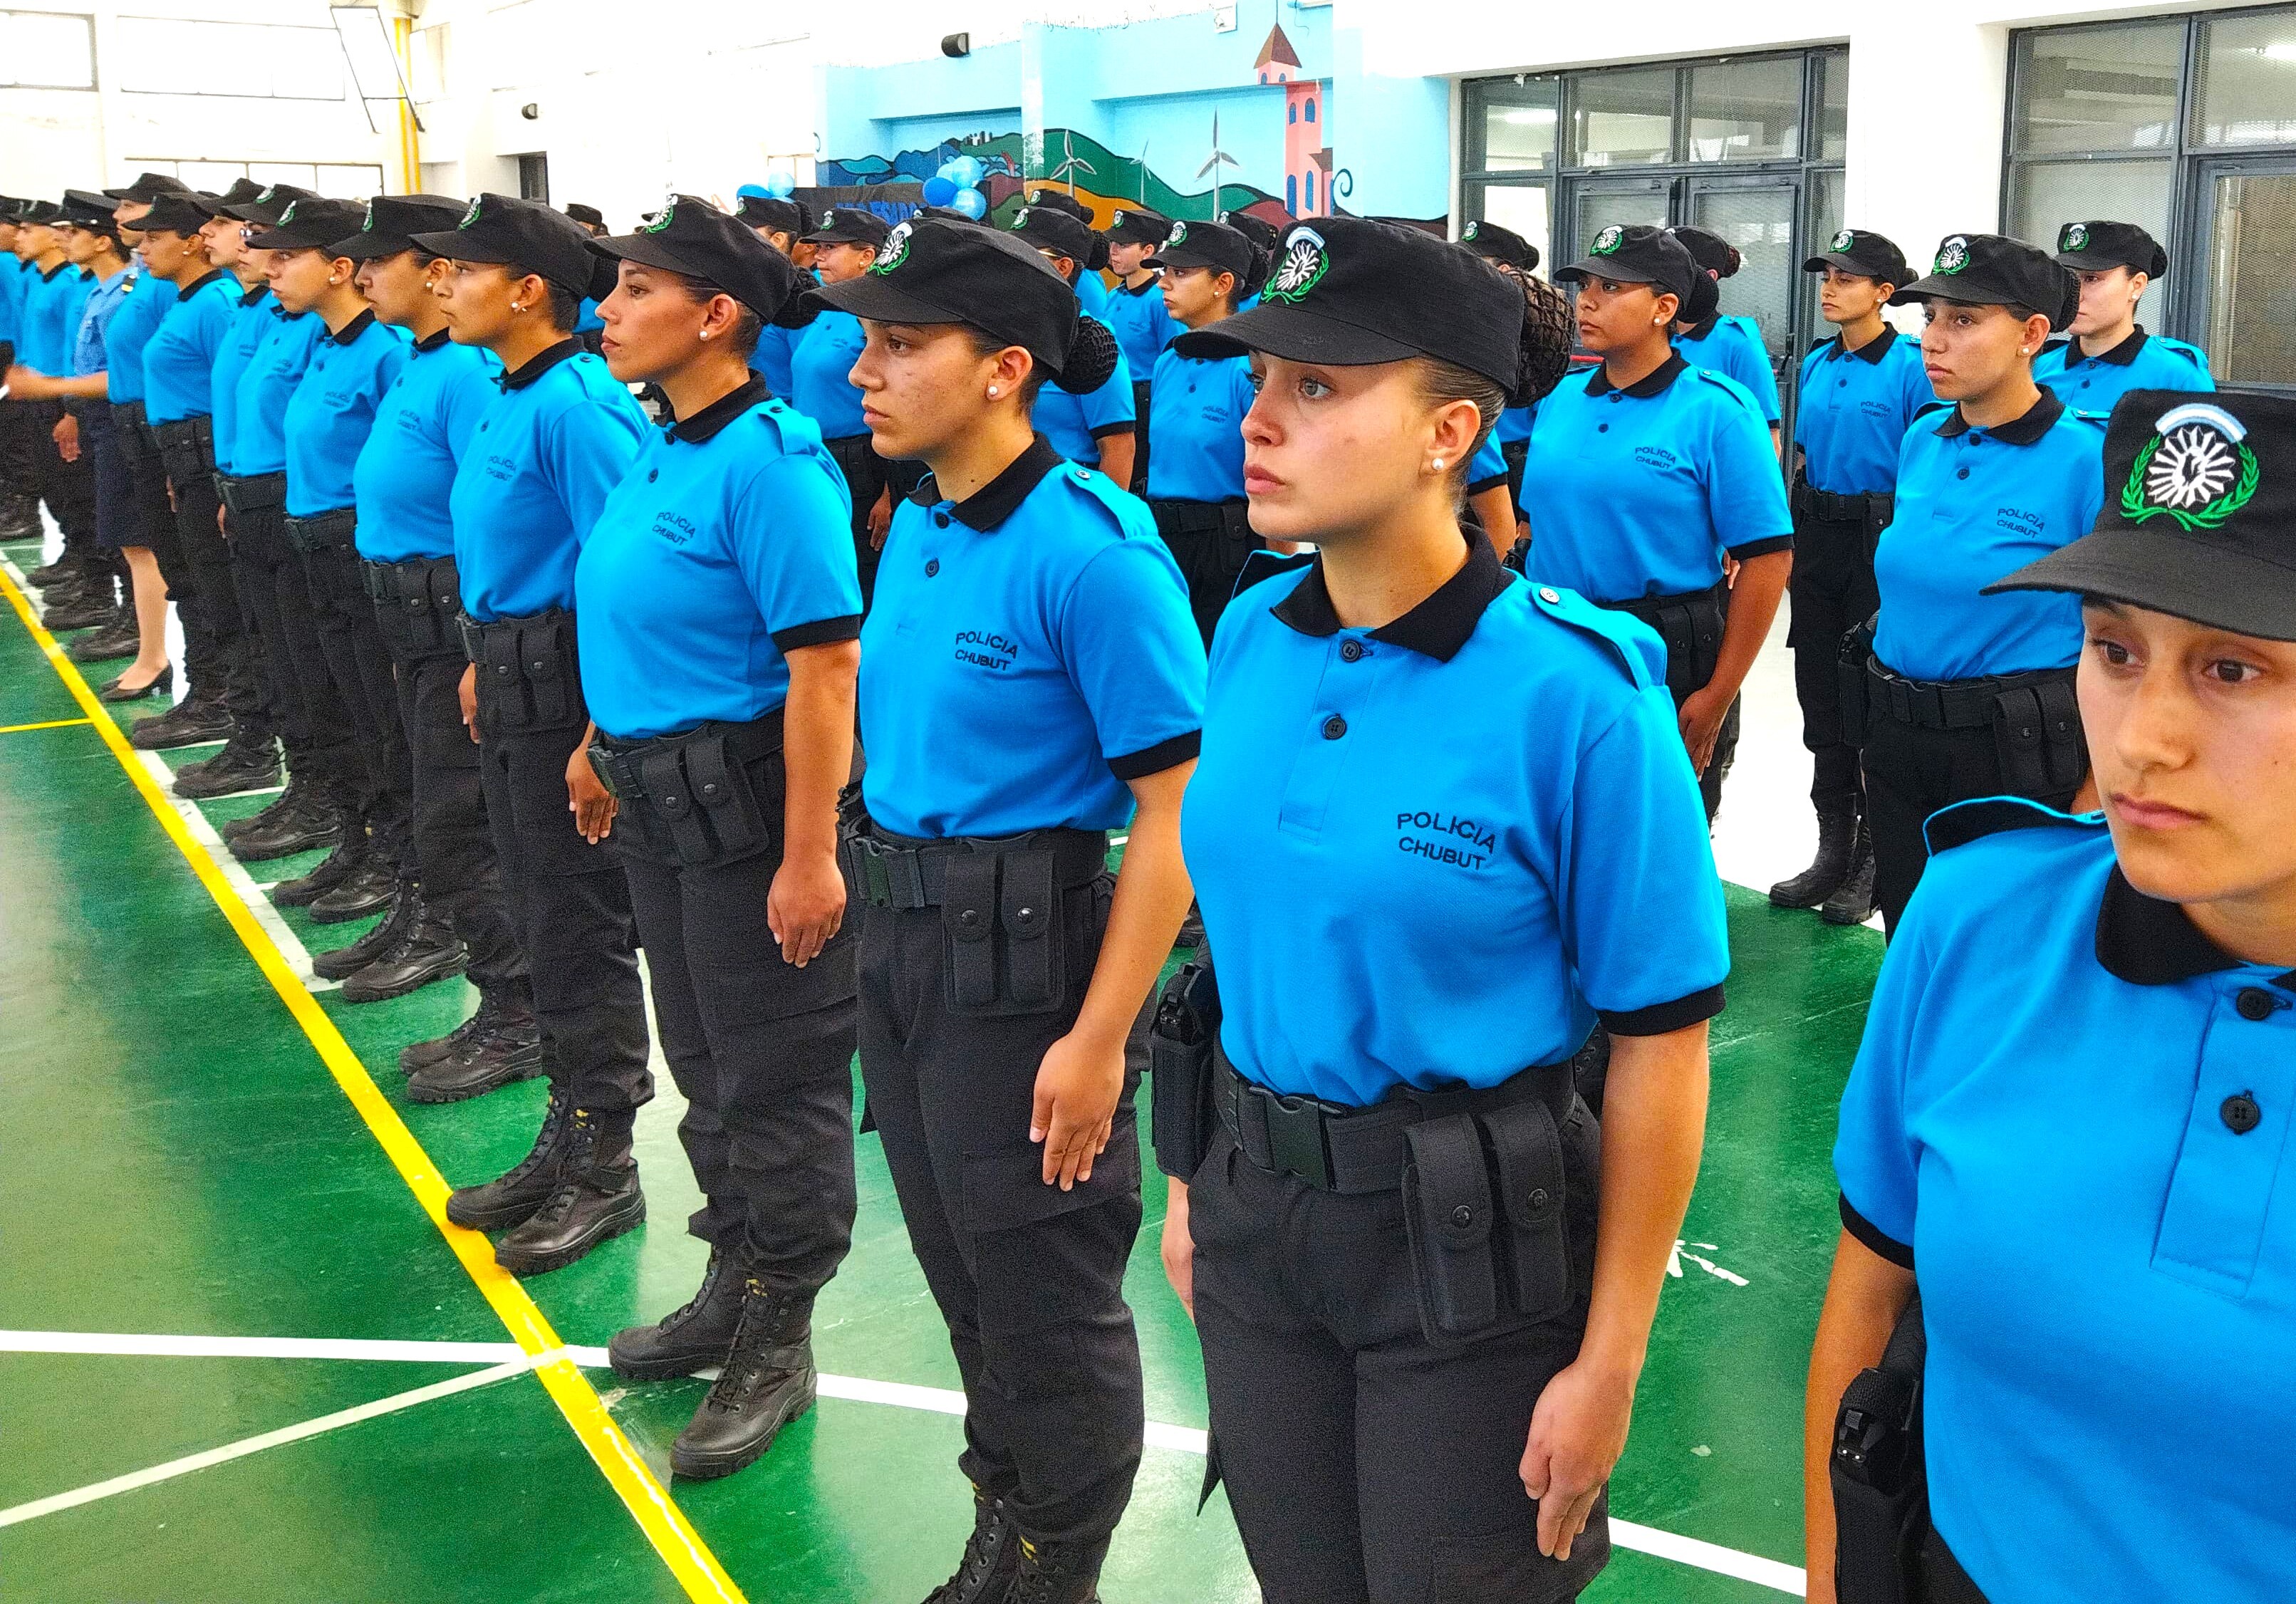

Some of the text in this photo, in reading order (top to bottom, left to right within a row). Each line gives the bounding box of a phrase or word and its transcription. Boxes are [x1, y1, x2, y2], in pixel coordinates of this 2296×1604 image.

[1635, 447, 1676, 464] POLICIA
[1635, 456, 1671, 470] CHUBUT
[656, 511, 696, 538] POLICIA
[1996, 519, 2039, 539] CHUBUT
[1997, 508, 2045, 533] POLICIA
[652, 524, 688, 546] CHUBUT
[955, 630, 1018, 660] POLICIA
[955, 649, 1012, 672] CHUBUT
[1397, 811, 1496, 855] POLICIA
[1398, 836, 1487, 870] CHUBUT
